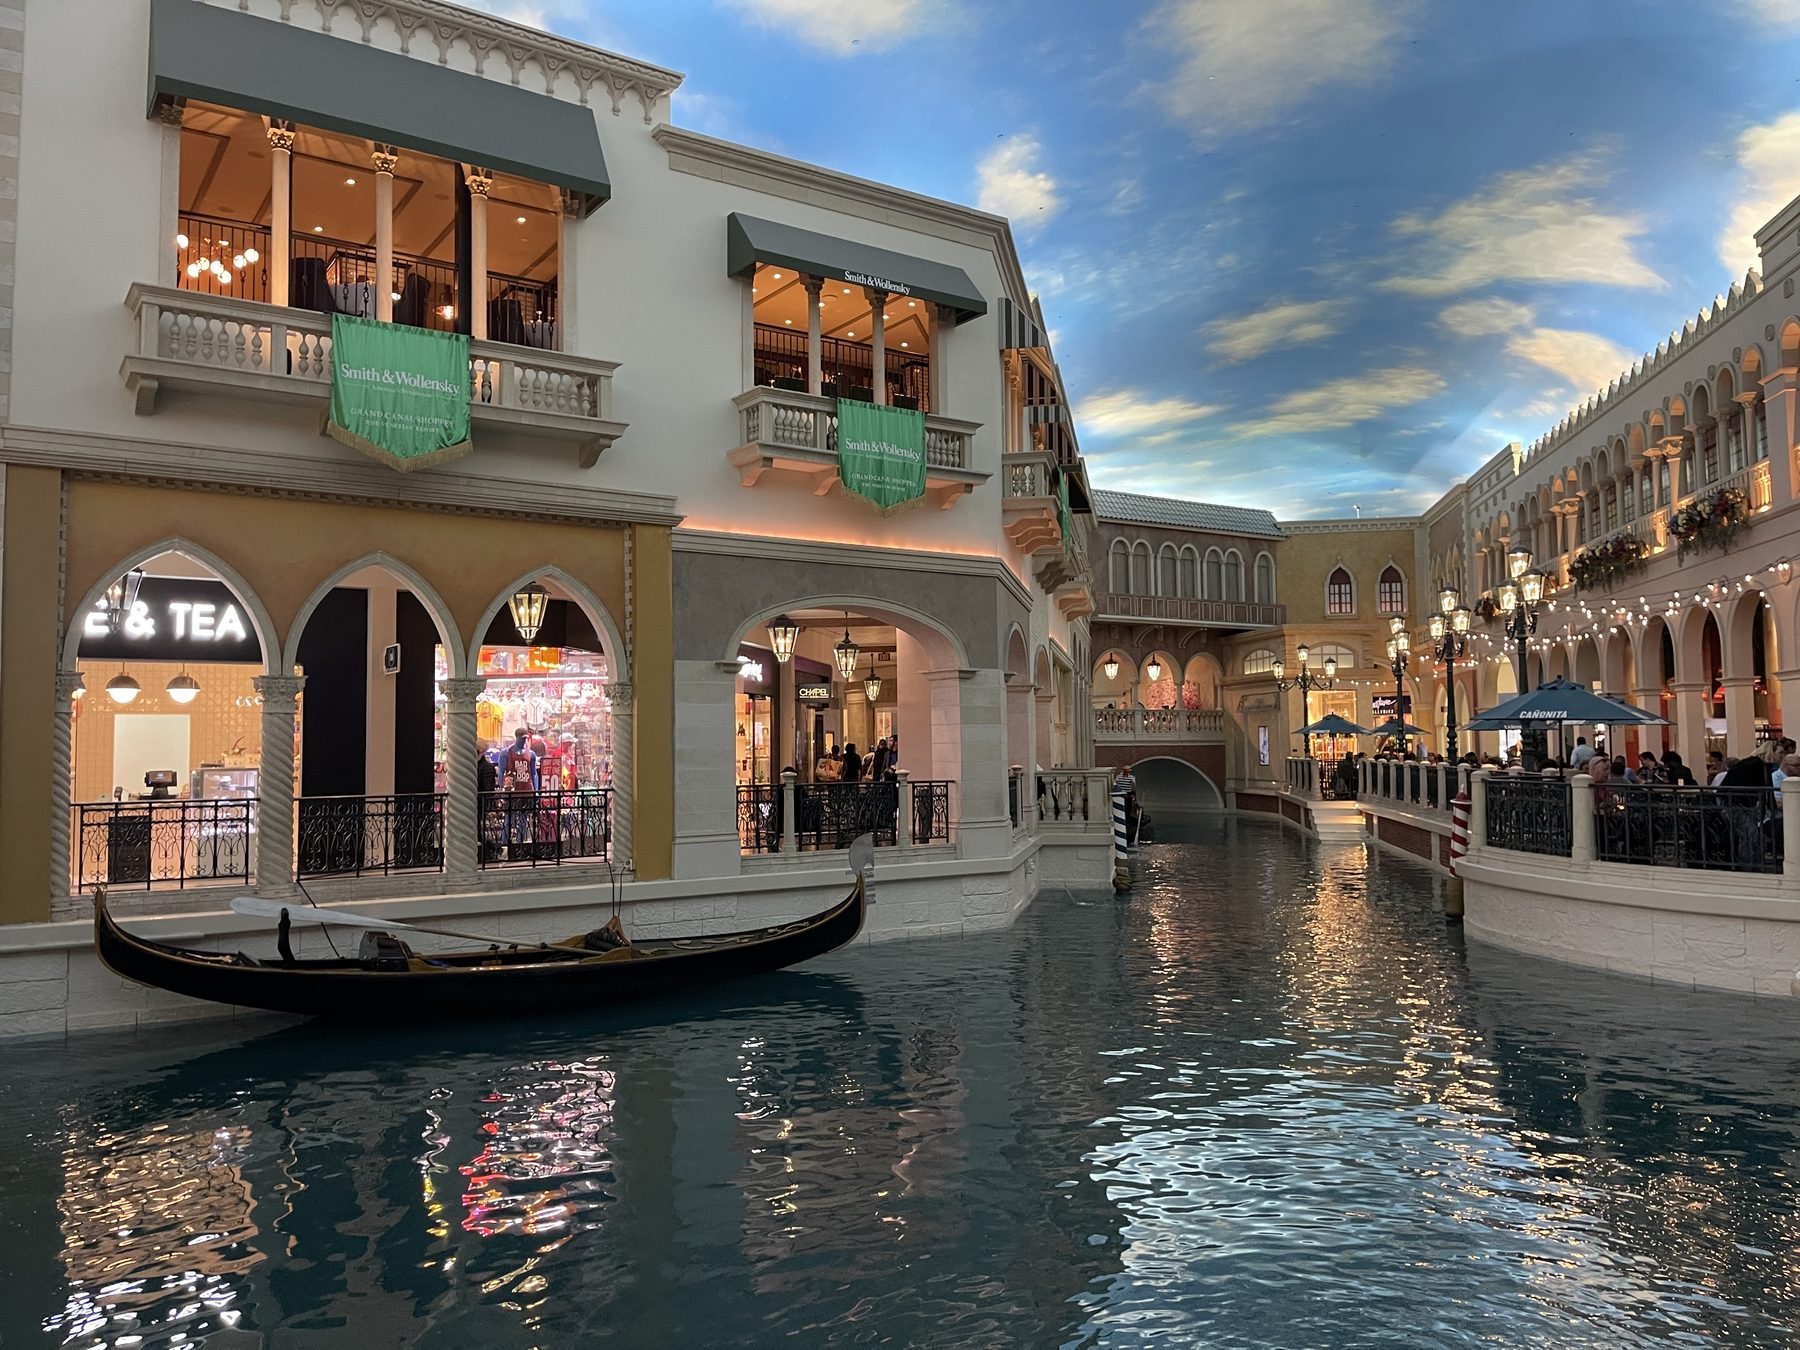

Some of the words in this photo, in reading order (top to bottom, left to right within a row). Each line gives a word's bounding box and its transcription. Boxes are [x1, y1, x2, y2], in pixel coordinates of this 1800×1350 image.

[844, 270, 867, 285] Smith
[867, 276, 875, 287] &
[874, 277, 911, 295] Wollensky
[341, 363, 380, 382] Smith
[382, 369, 395, 385] &
[395, 371, 460, 396] Wollensky
[350, 407, 384, 418] GRAND
[384, 412, 415, 422] CANAL
[845, 437, 871, 451] Smith
[871, 441, 880, 453] &
[879, 442, 921, 462] Wollensky
[125, 600, 156, 637] &
[169, 602, 247, 639] TEA
[1519, 709, 1568, 719] CAÑONITA
[541, 774, 559, 797] 50
